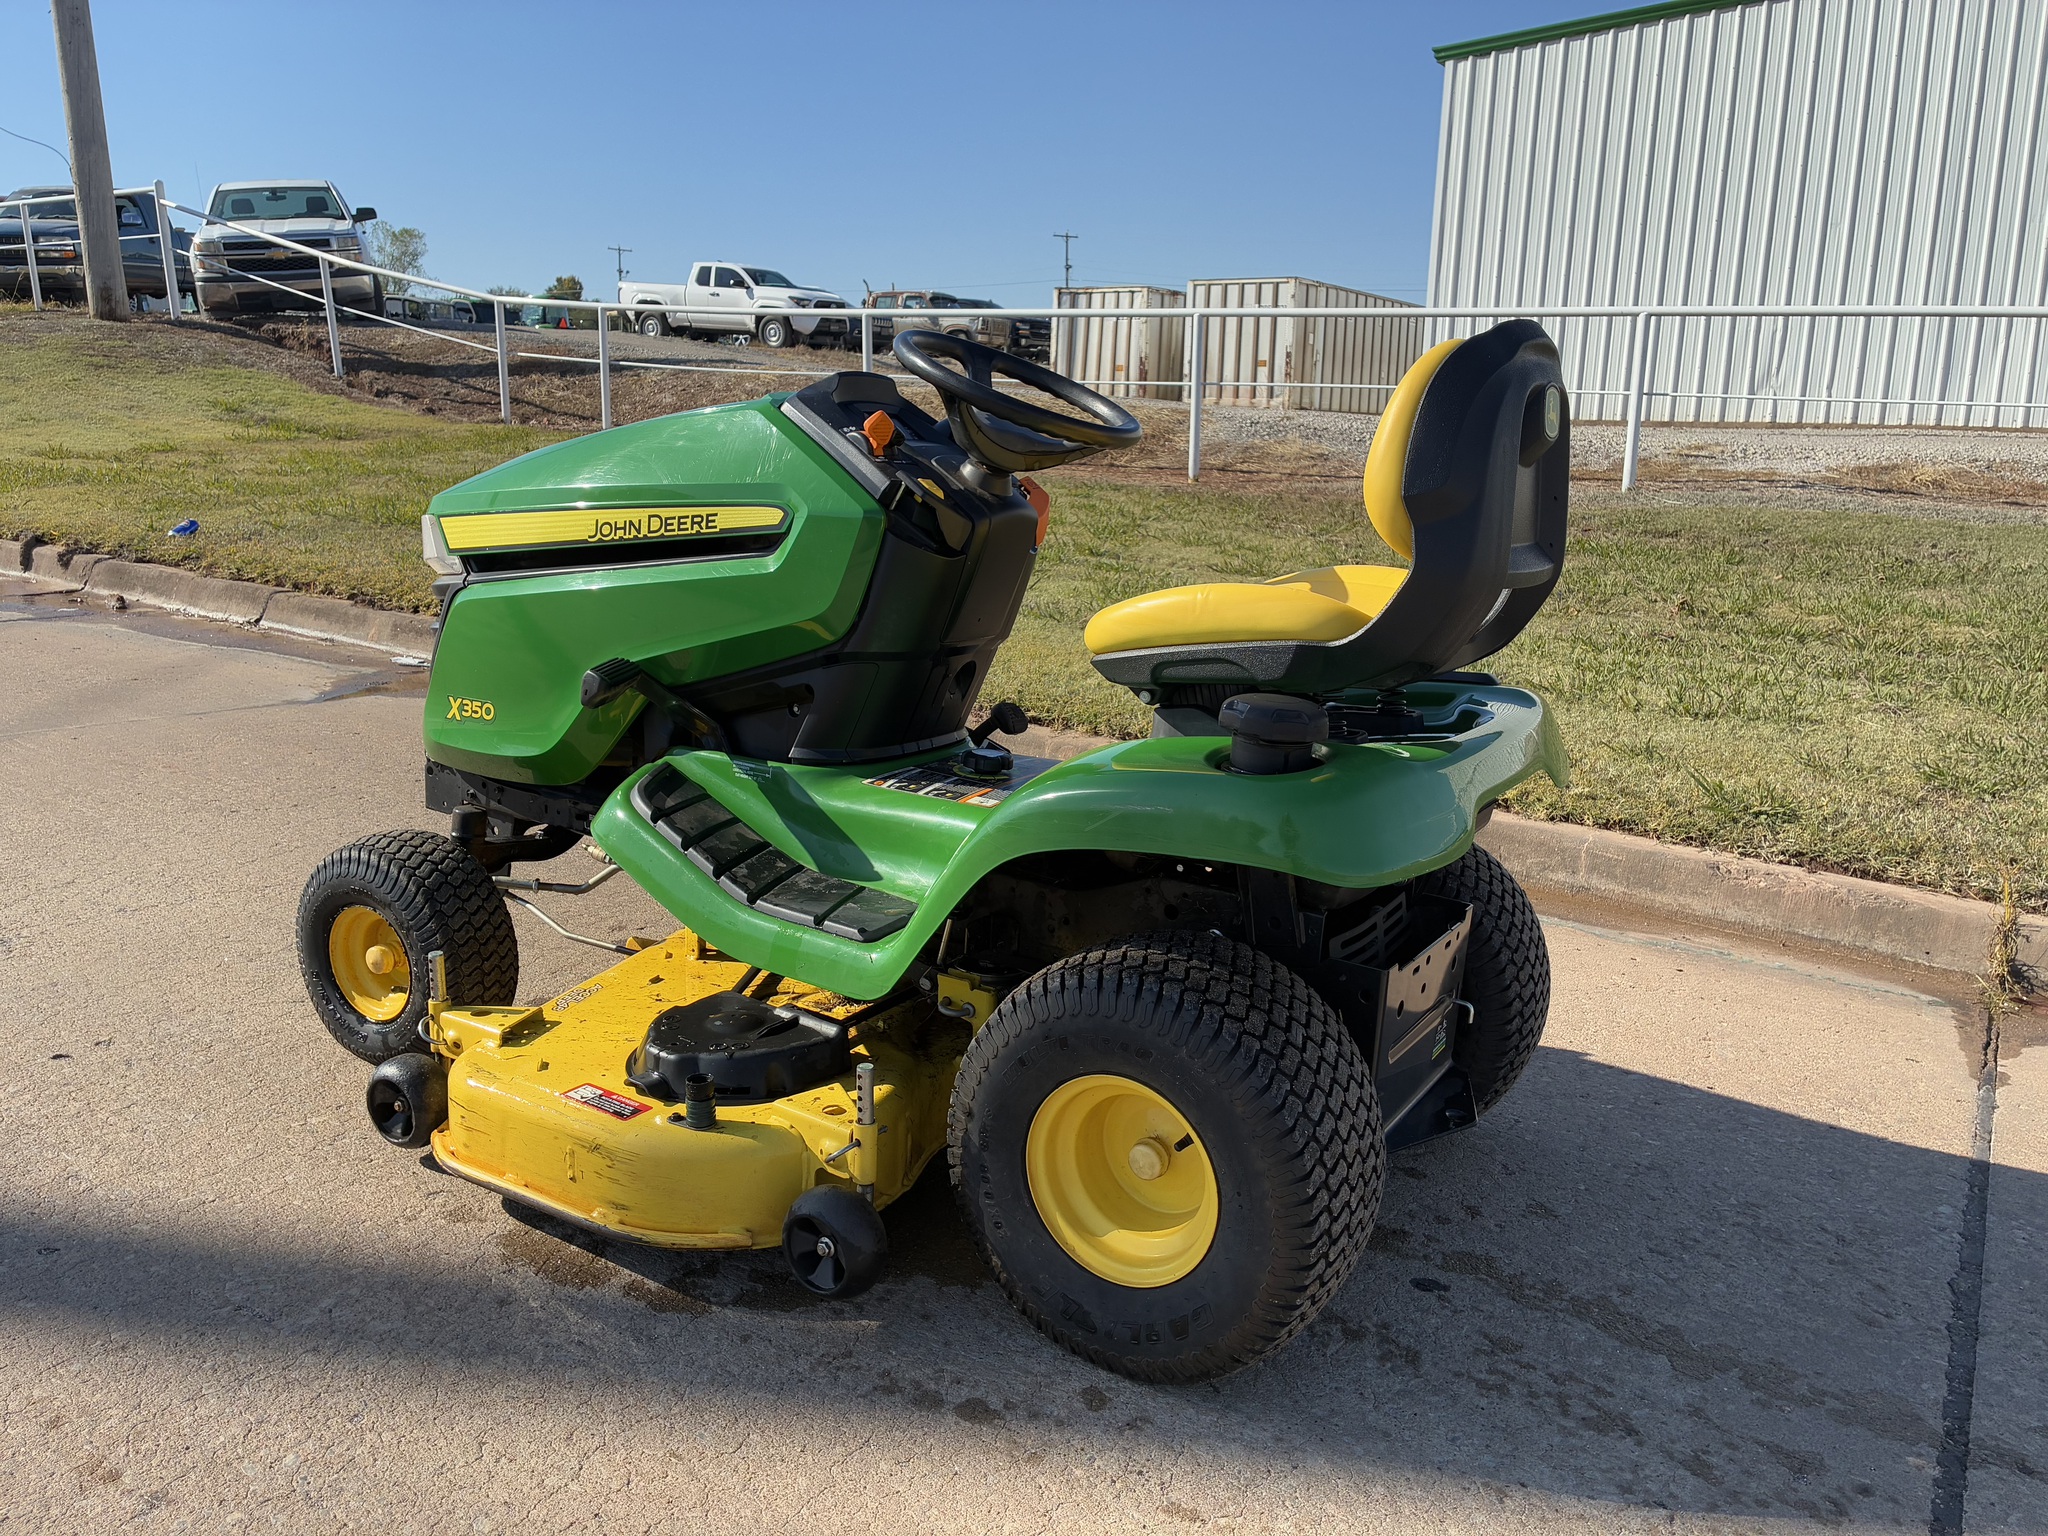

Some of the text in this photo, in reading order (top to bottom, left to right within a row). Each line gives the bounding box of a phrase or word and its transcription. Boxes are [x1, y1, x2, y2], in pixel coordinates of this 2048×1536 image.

[587, 512, 719, 541] JOHN DEERE
[447, 695, 495, 722] X350
